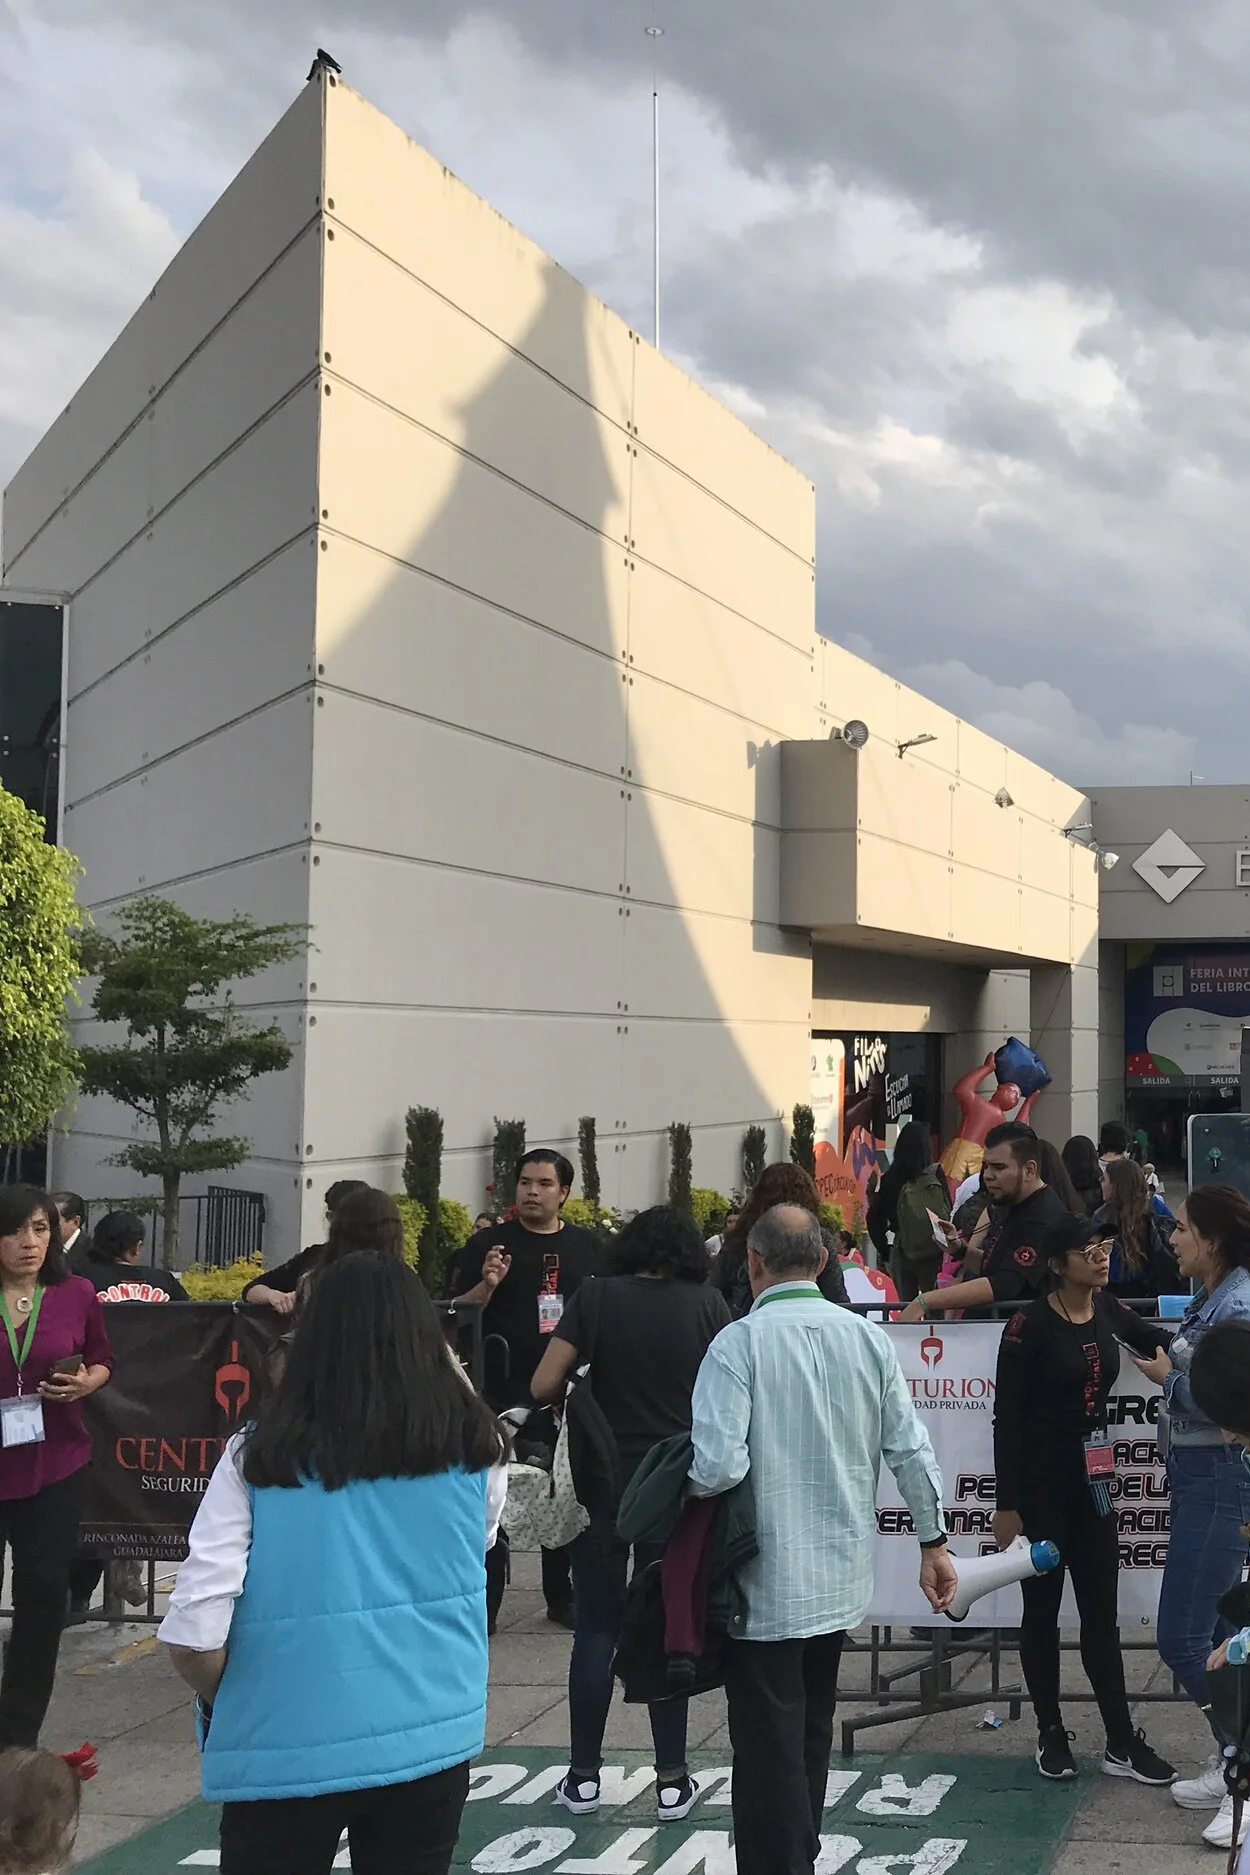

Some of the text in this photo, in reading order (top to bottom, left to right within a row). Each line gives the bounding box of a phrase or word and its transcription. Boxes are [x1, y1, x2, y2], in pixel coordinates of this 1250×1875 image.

[1190, 967, 1225, 979] FERIA
[1190, 982, 1213, 993] DEL
[1142, 1077, 1171, 1085] SALIDA
[940, 1400, 987, 1410] PRIVADA
[83, 1532, 148, 1544] RINCONADA
[113, 1546, 184, 1558] GUADALAJARA
